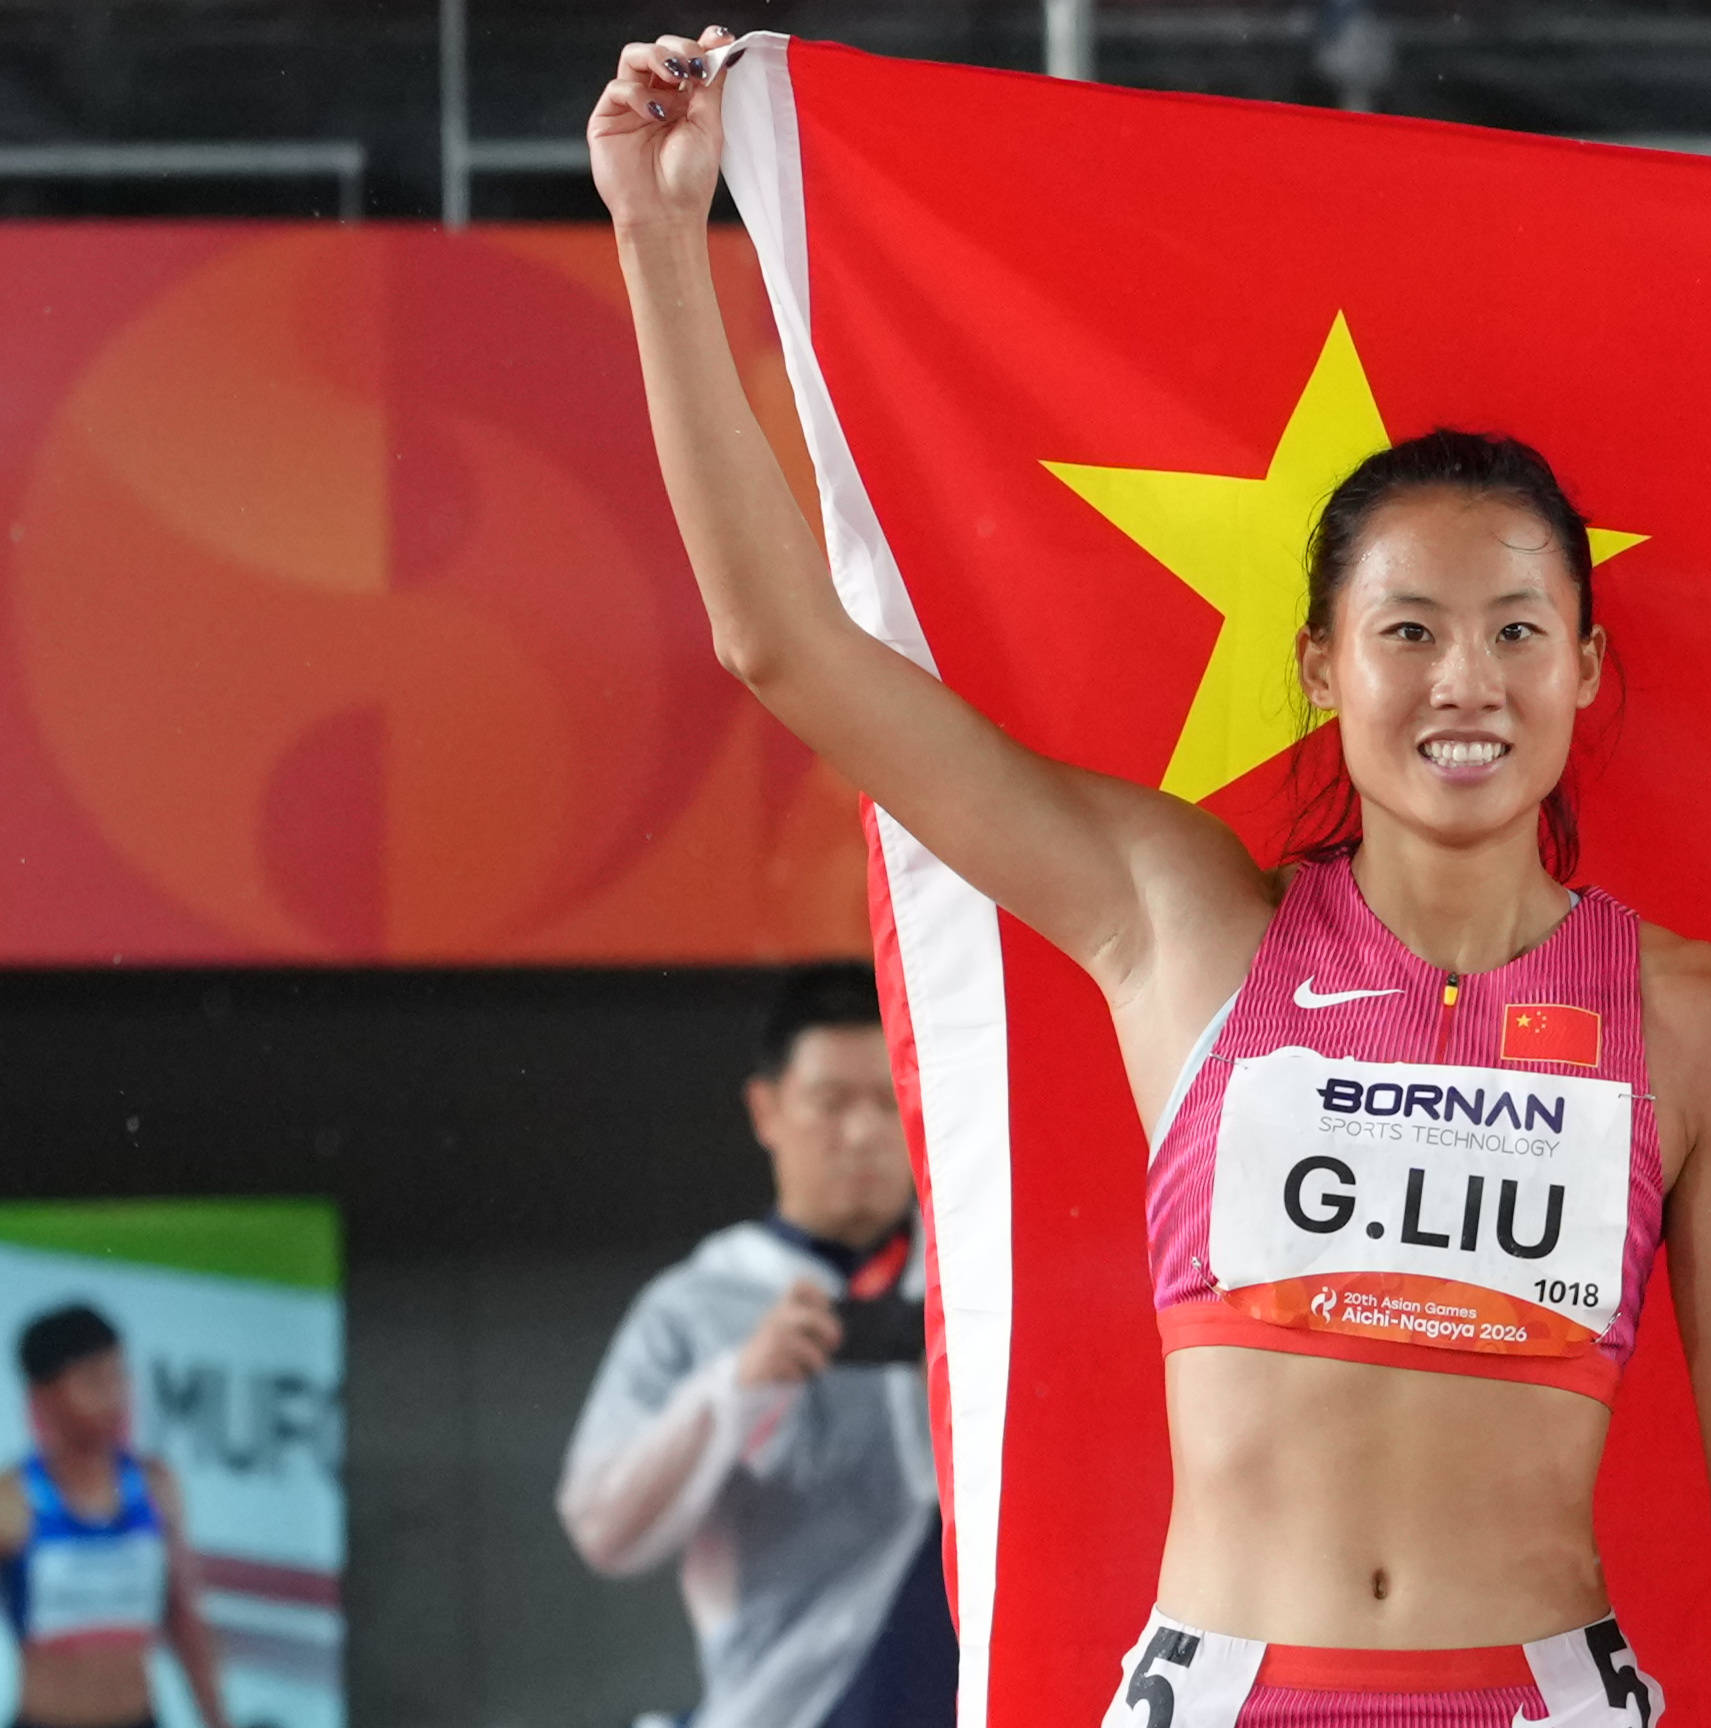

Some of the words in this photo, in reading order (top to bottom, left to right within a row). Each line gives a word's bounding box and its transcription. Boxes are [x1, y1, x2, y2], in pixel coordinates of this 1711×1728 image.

[1316, 1078, 1565, 1134] BORNAN
[1319, 1116, 1403, 1140] SPORTS
[1411, 1125, 1560, 1157] TECHNOLOGY
[1283, 1155, 1566, 1260] G.LIU
[1343, 1292, 1377, 1306] 20th
[1381, 1297, 1421, 1313] Asian
[1424, 1302, 1477, 1319] Games
[1534, 1279, 1599, 1307] 1018
[1341, 1309, 1475, 1339] Aichi-Nagoya
[1479, 1324, 1528, 1342] 2026
